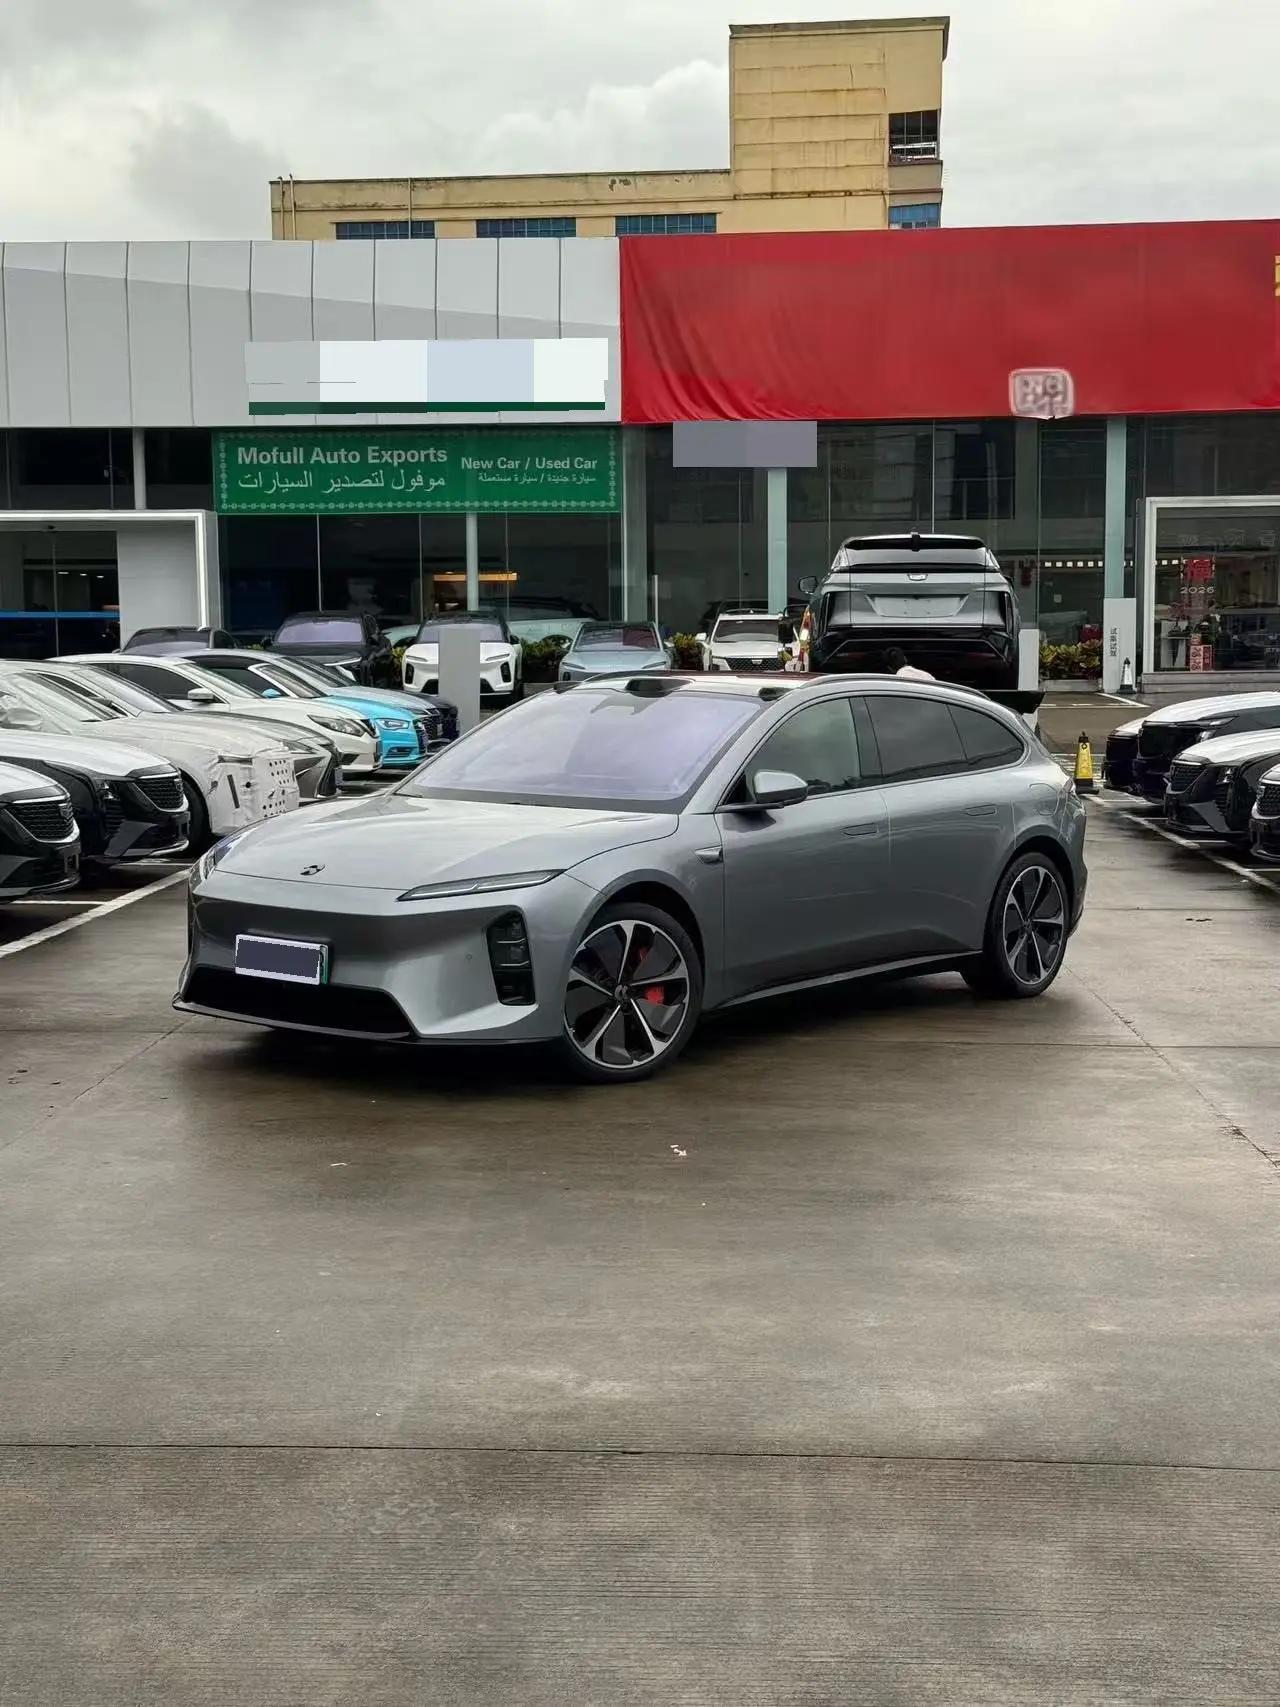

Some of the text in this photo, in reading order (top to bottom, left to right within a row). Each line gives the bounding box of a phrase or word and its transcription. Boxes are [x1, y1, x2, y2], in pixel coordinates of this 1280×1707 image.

[238, 446, 448, 467] Mofull Auto Exports
[461, 457, 597, 470] New Car / Used Car
[238, 469, 445, 493] موفول لتصدير السيارات
[1180, 586, 1214, 594] 2026
